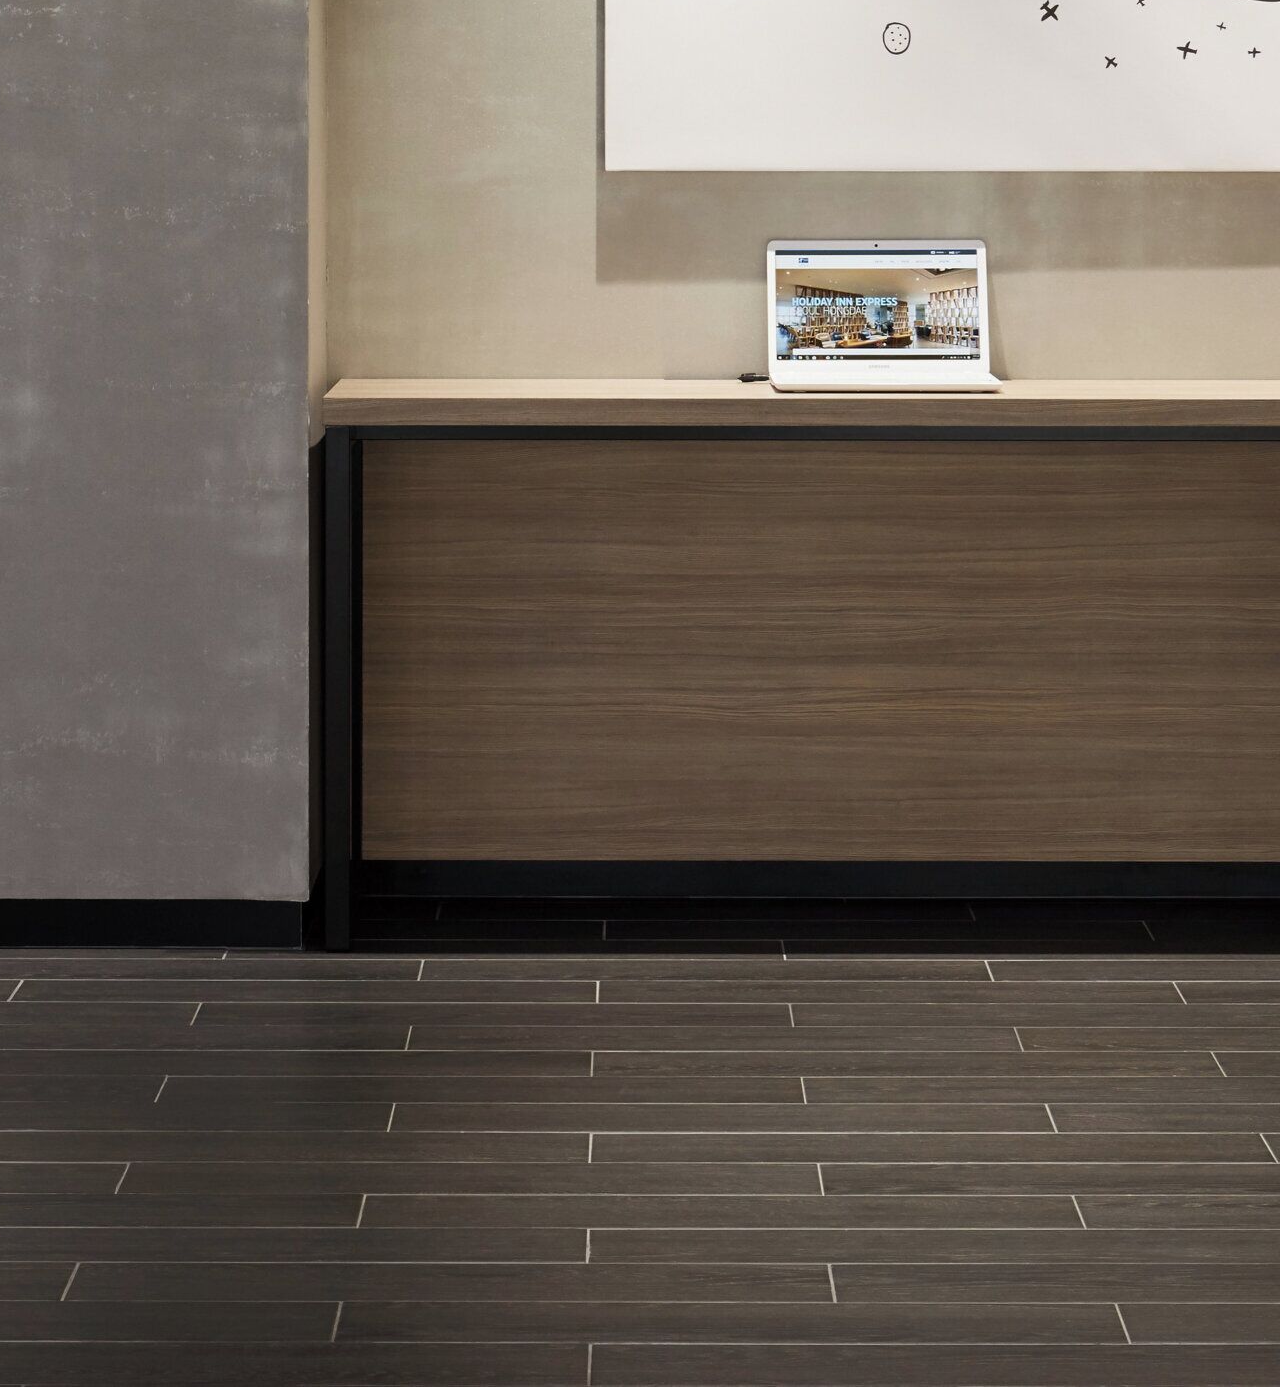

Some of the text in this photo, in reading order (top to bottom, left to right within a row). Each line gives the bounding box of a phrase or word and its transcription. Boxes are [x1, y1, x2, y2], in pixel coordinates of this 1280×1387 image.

[792, 297, 833, 306] HOLIDAY
[836, 297, 852, 305] INN
[823, 306, 866, 316] HONGDAE
